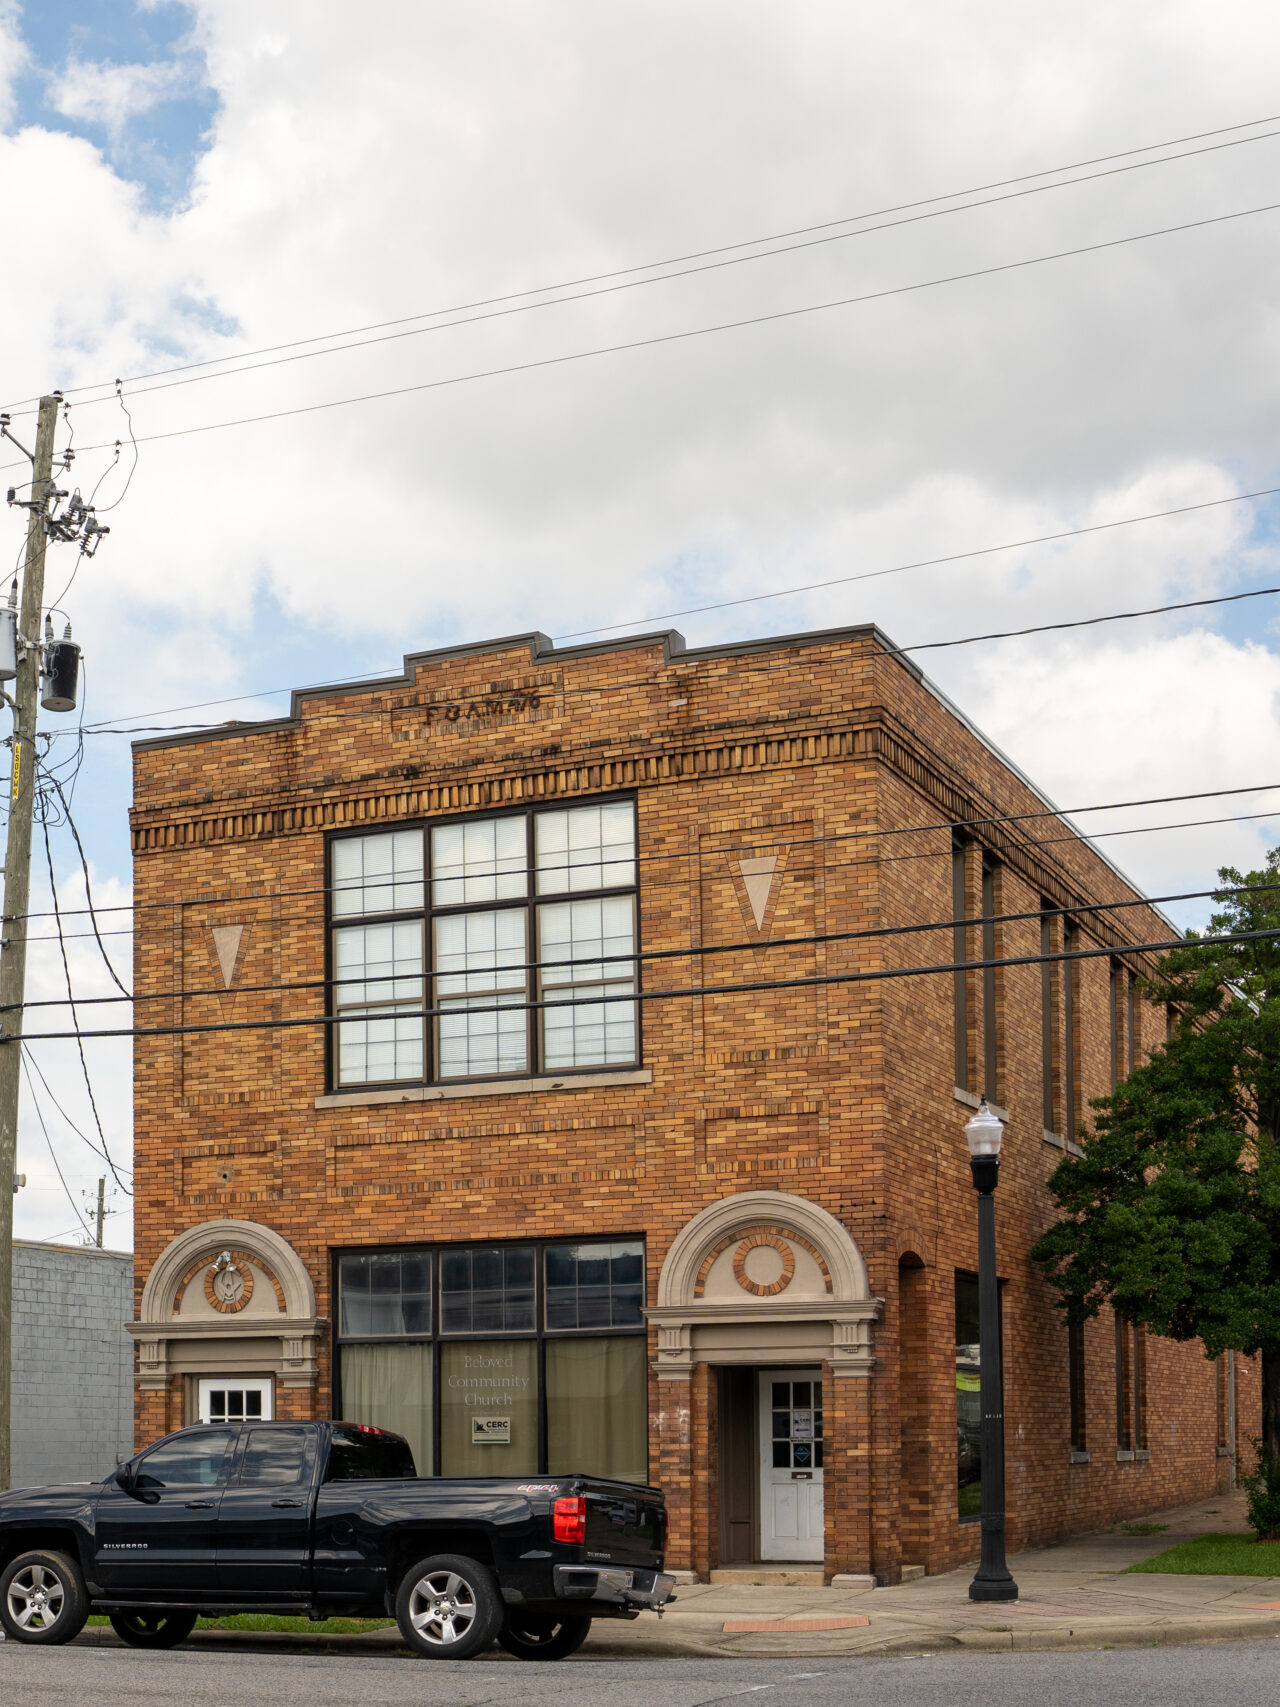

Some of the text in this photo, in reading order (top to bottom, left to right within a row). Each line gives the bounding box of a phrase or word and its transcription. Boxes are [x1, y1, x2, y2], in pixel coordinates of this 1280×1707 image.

[463, 1355, 513, 1368] Beloved
[448, 1374, 529, 1391] Community
[464, 1392, 513, 1406] Church
